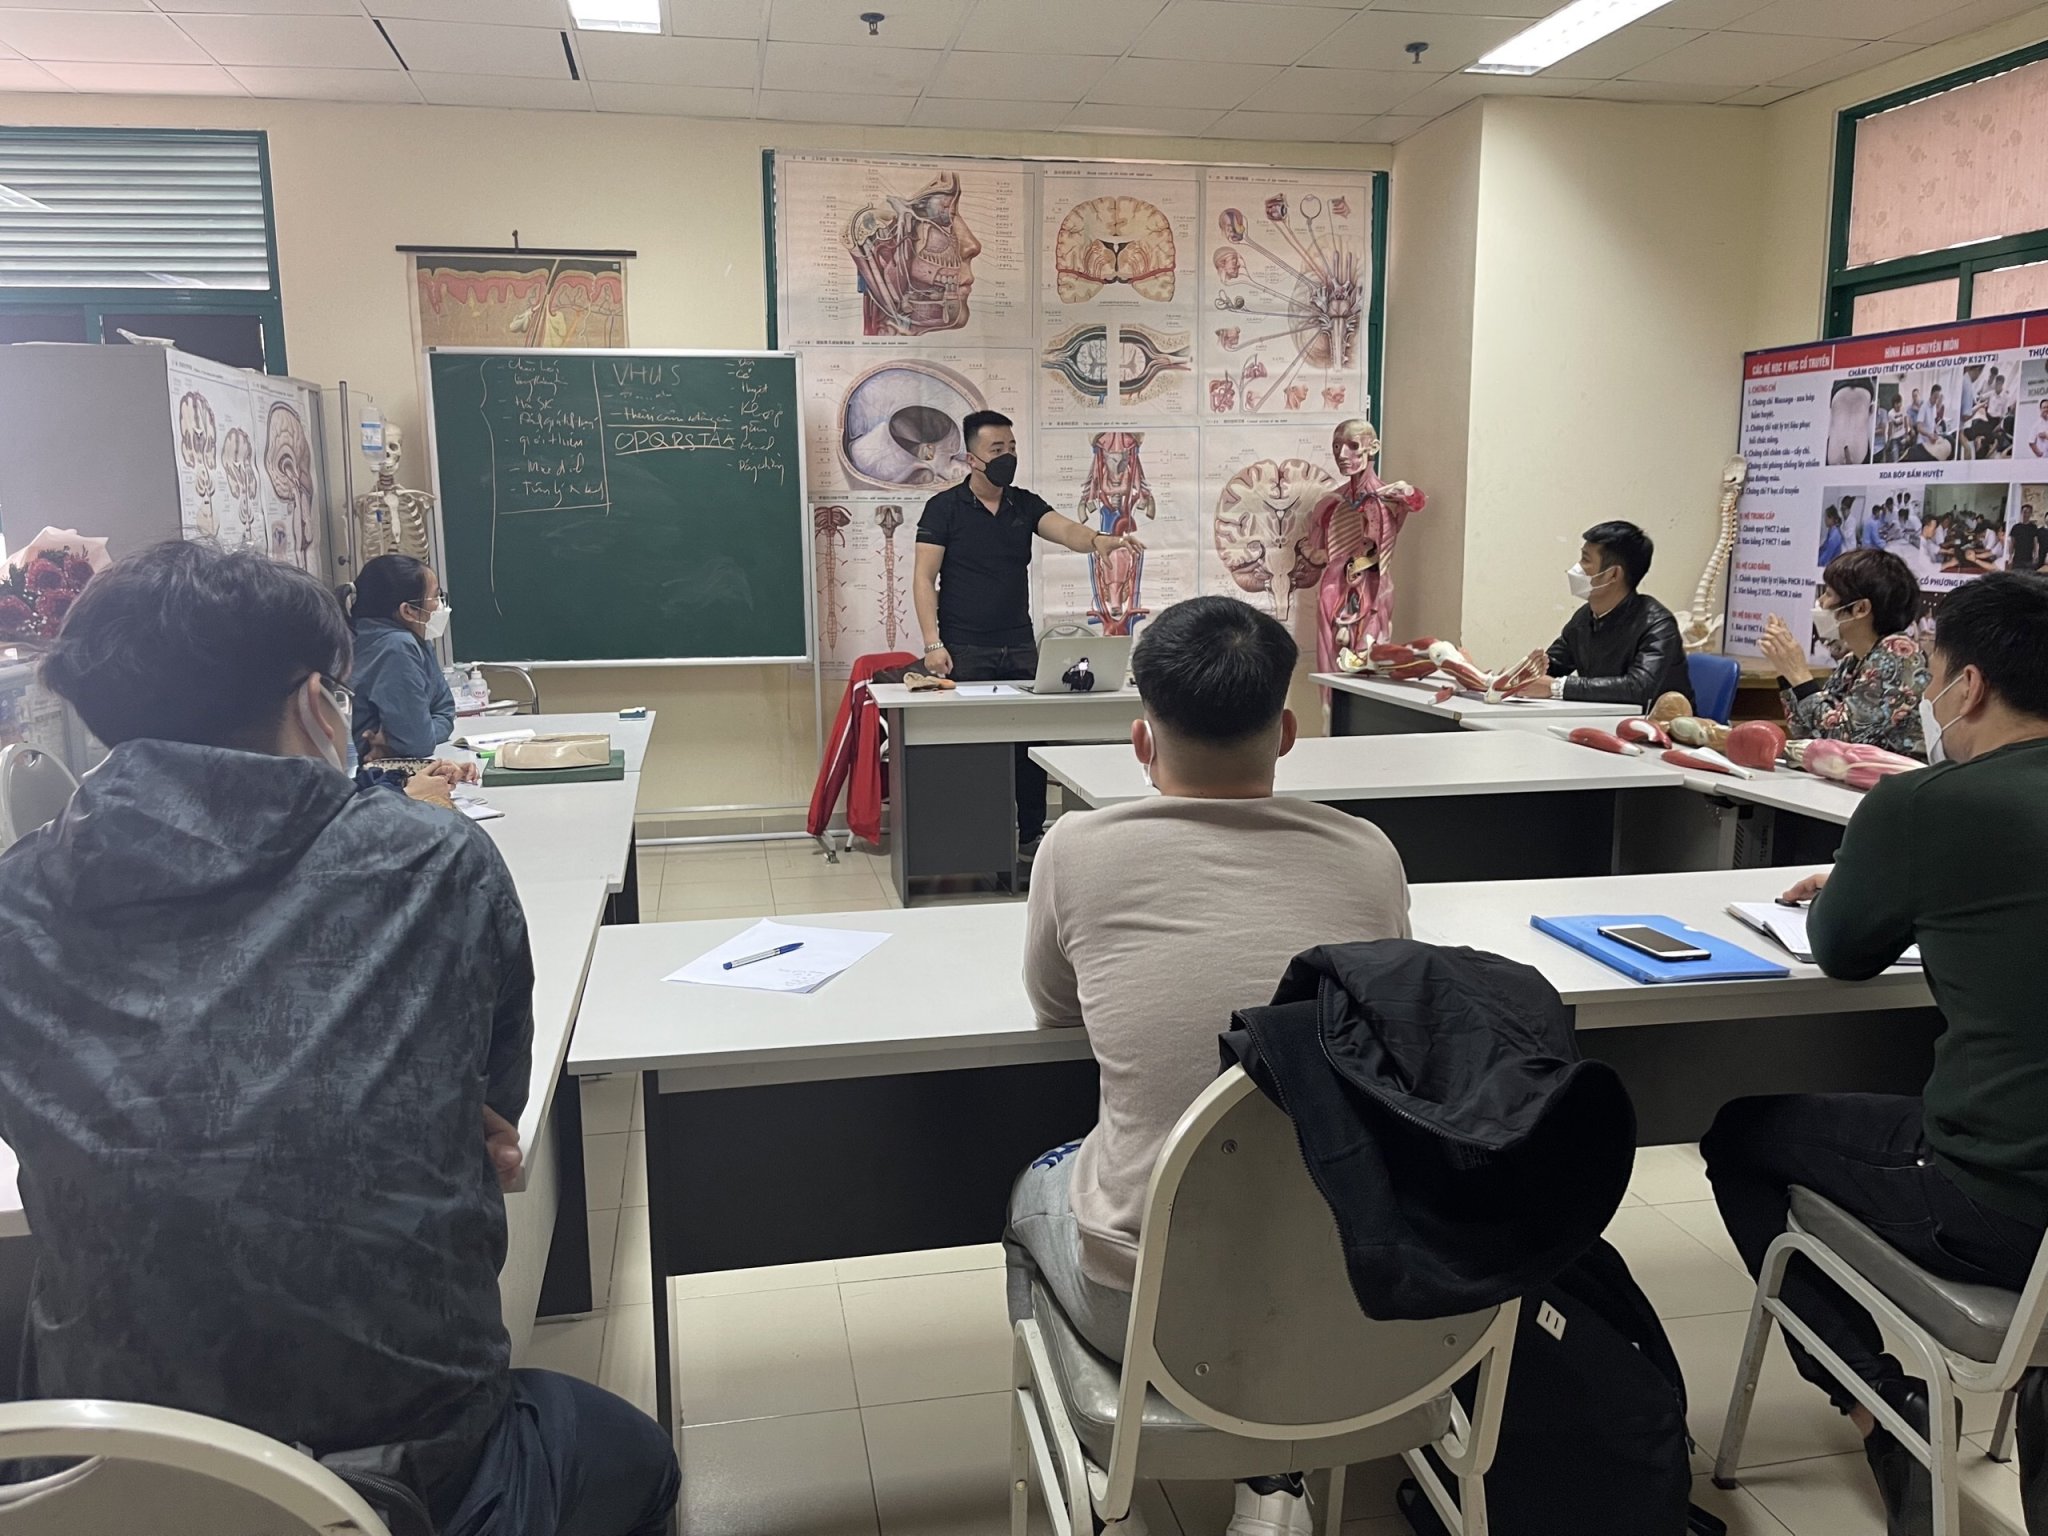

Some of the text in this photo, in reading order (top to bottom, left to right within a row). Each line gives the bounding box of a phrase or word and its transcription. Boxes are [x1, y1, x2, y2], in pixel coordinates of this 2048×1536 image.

[1916, 340, 1942, 355] CHUYÊN
[1848, 366, 1867, 377] CHÂM
[1868, 365, 1882, 376] CỨU
[1900, 362, 1915, 373] HỌC
[1916, 359, 1937, 370] CHÂM
[1937, 357, 1953, 368] CỨU
[1953, 355, 1967, 366] LỚP
